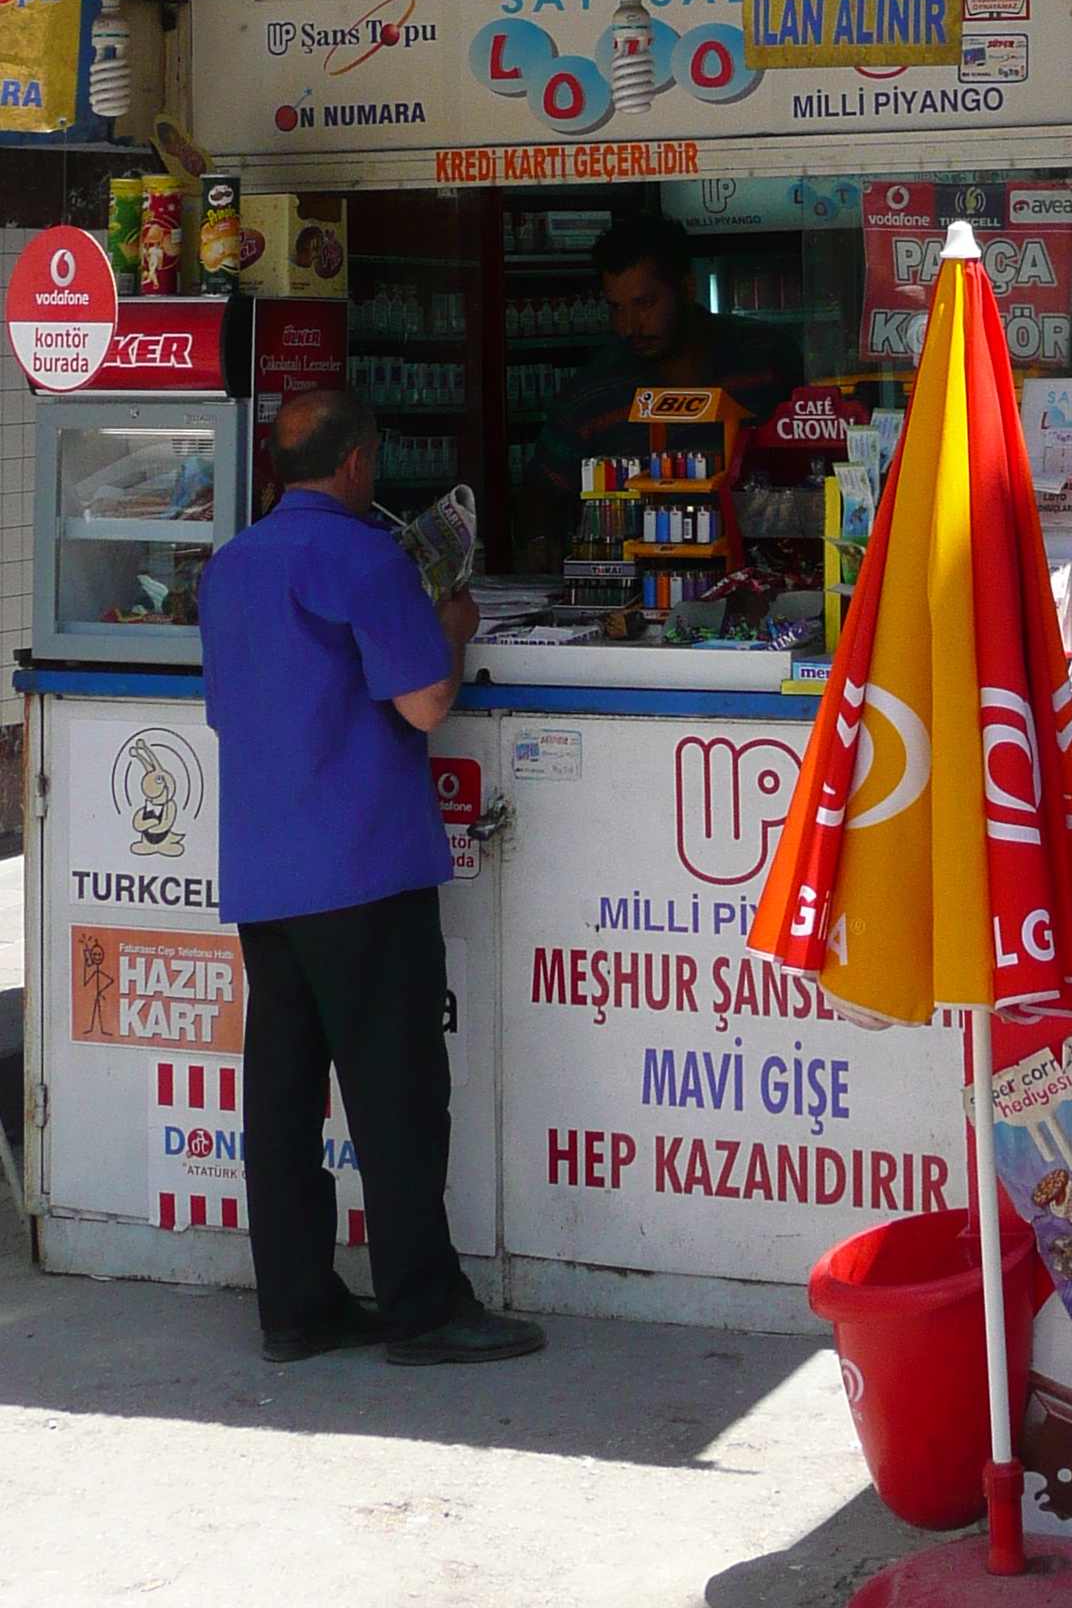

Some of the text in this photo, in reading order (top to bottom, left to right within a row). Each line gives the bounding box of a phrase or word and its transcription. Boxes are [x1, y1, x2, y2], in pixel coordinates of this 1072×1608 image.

[300, 21, 360, 55] Şans
[323, 101, 427, 129] NUMARA
[873, 87, 1005, 117] PİYANGO
[503, 148, 567, 182] KARTI
[868, 212, 930, 226] vodafone
[893, 238, 1057, 295] PAÇA
[35, 289, 90, 306] vodafone
[34, 326, 89, 349] kontör
[32, 353, 90, 374] burada
[794, 396, 834, 416] CAFÉ
[777, 417, 856, 440] CROWN
[591, 566, 622, 575] TOKAI
[599, 891, 700, 934] MİLLİ
[157, 945, 175, 957] Cep
[119, 955, 234, 1003] HAZIR
[531, 947, 699, 1026] MEŞHUR
[119, 998, 220, 1044] KART
[641, 1036, 851, 1136] MAVİ GİŞE
[547, 1128, 949, 1214] HEP KAZANDIRIR
